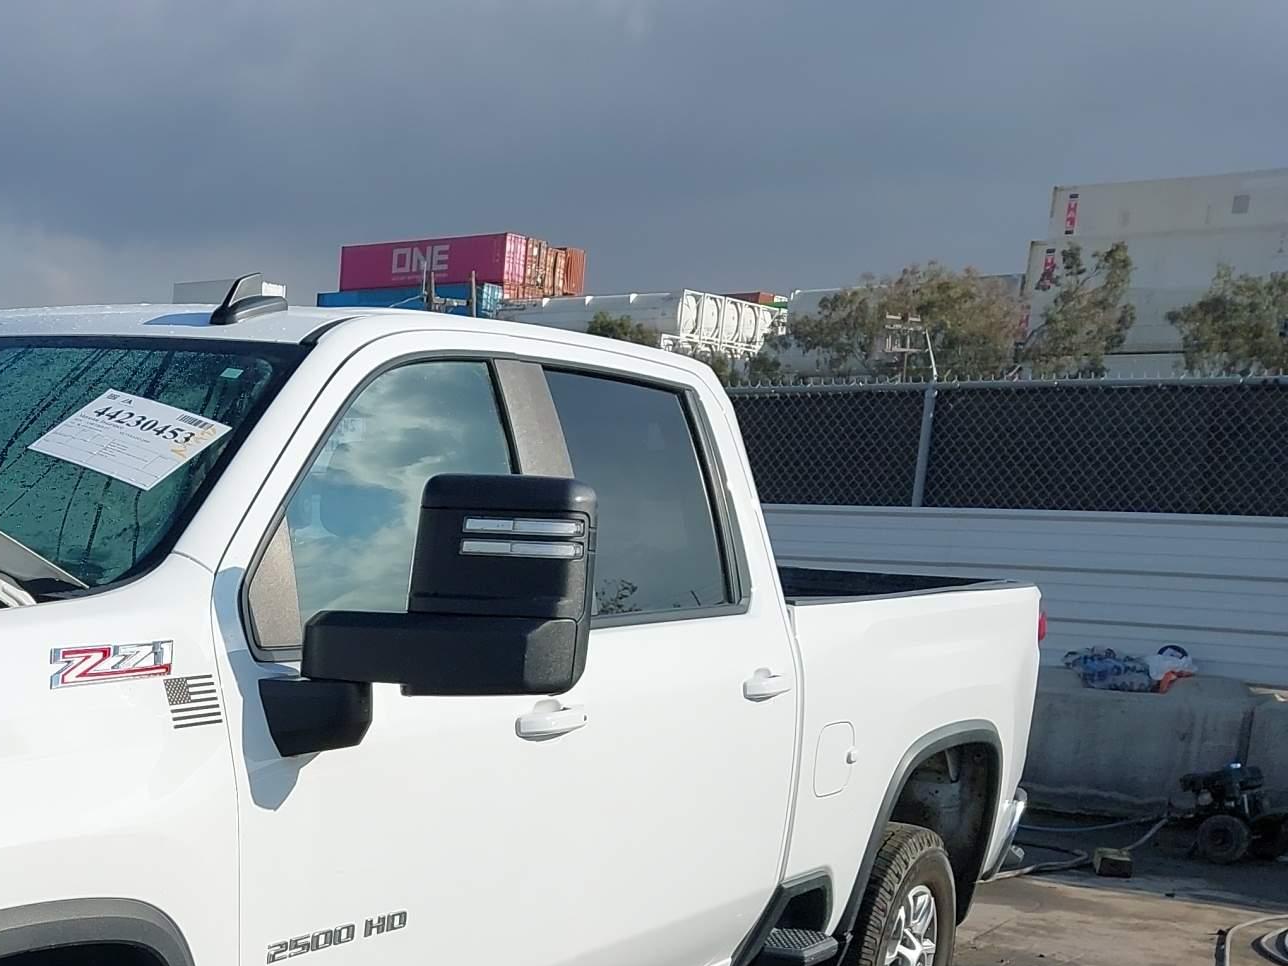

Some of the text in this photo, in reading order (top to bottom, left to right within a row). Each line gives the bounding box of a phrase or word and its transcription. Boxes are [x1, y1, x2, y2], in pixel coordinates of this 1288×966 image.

[392, 244, 450, 274] ONE
[93, 406, 195, 444] 44230453
[50, 640, 173, 689] Z71
[266, 910, 408, 965] 2500 HD
